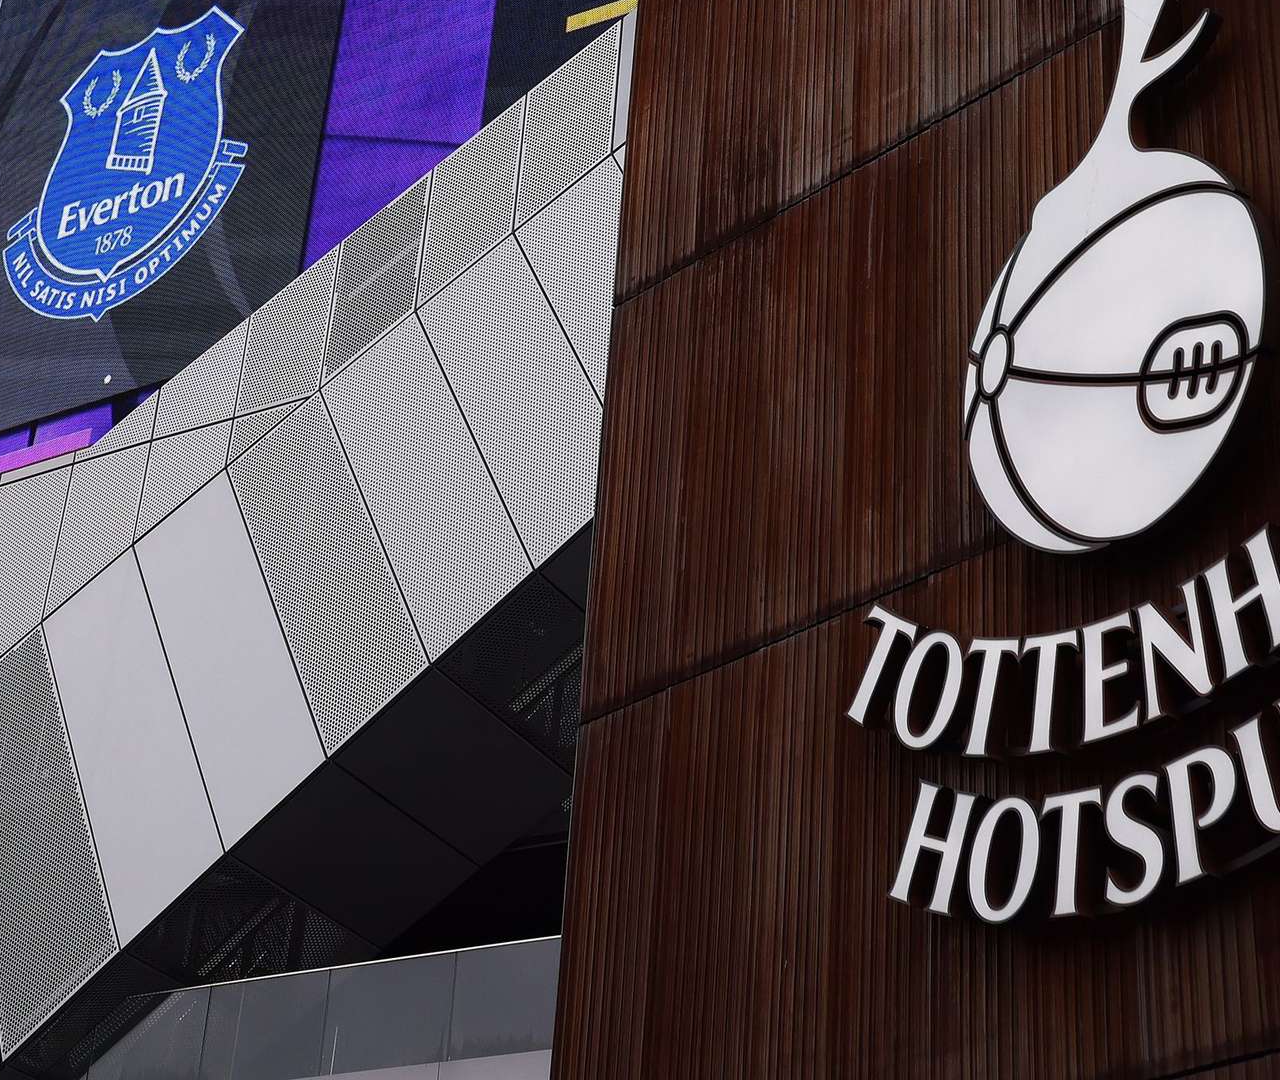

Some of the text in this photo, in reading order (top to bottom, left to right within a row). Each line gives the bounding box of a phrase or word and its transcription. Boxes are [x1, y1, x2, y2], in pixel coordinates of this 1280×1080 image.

[57, 171, 185, 240] Everton
[94, 224, 133, 256] 1878
[12, 183, 227, 310] NIL SATIS NISI OPTIMUM
